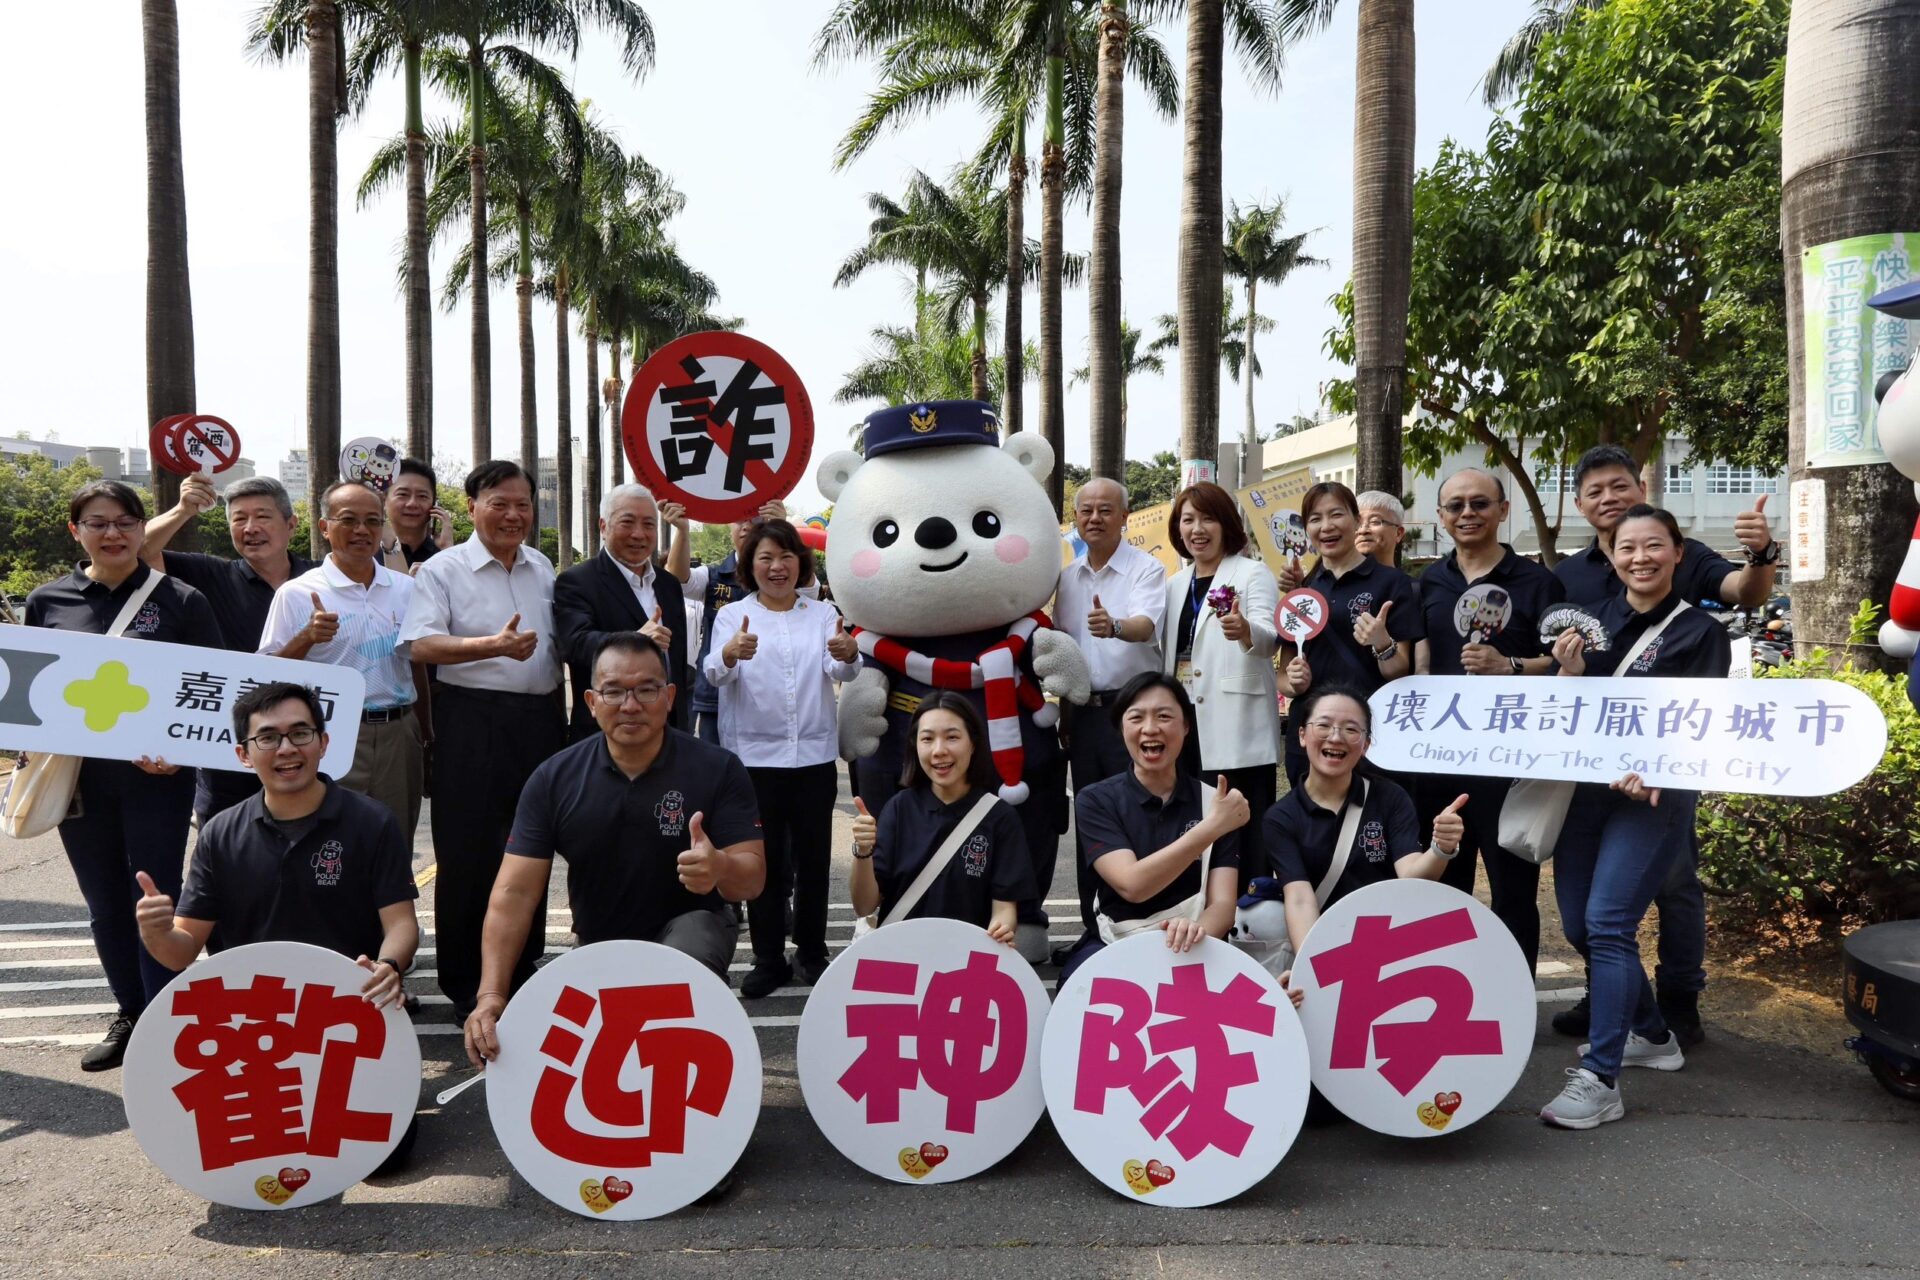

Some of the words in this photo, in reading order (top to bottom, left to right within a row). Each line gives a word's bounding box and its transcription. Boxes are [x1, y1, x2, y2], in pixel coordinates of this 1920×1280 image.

[1827, 259, 1860, 450] 平平安安回家
[659, 353, 786, 493] 詐
[1283, 598, 1315, 632] 家暴
[175, 671, 340, 722] 嘉市
[1382, 689, 1852, 746] 壞人最討厭的城市
[167, 722, 232, 744] CHIA
[1409, 742, 1479, 766] Chiayi
[1616, 752, 1711, 778] Safest
[1725, 758, 1792, 786] City
[965, 862, 985, 873] POLICE
[966, 869, 981, 878] BEAR
[1365, 850, 1387, 858] POLICE
[1369, 855, 1386, 863] BEAR
[1309, 907, 1503, 1096] 友
[837, 950, 1028, 1134] 神
[1074, 963, 1276, 1162] 隊
[171, 974, 393, 1171] 歡
[531, 982, 735, 1168] 迎
